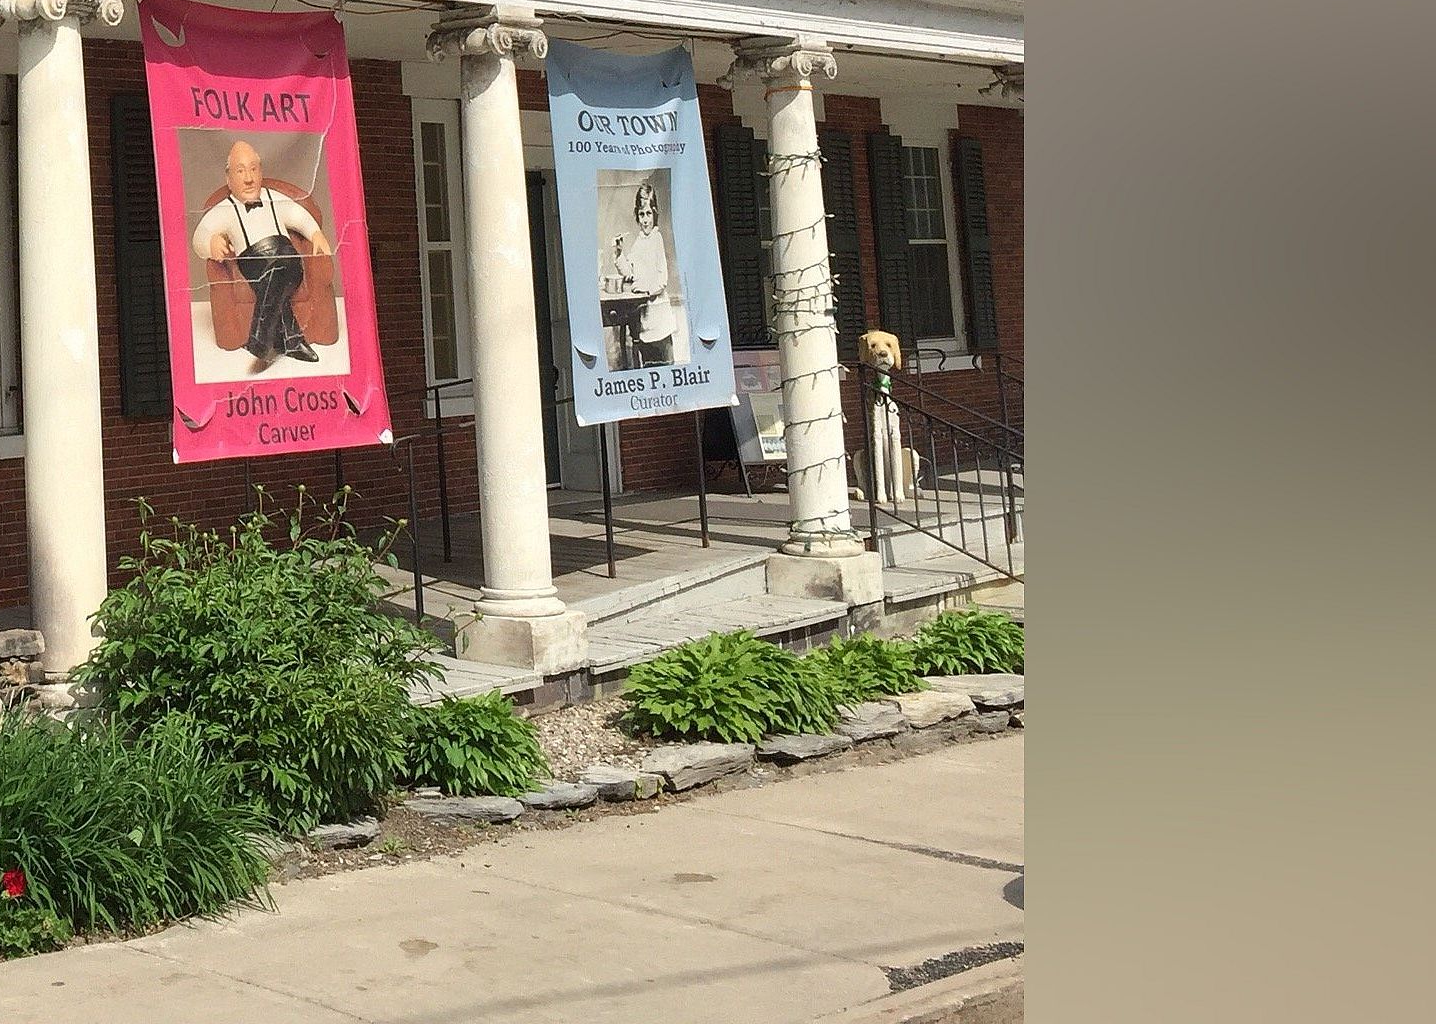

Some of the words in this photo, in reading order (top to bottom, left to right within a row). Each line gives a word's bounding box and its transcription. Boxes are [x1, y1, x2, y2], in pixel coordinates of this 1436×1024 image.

[191, 87, 254, 122] FOLK
[262, 93, 310, 123] ART
[616, 111, 678, 136] TOWN
[568, 141, 592, 153] 100
[594, 377, 645, 397] James
[649, 371, 666, 390] P.
[671, 365, 711, 387] Blair
[226, 386, 277, 417] John
[285, 387, 338, 412] Cross
[630, 394, 678, 411] Curator
[259, 423, 316, 445] Carver
